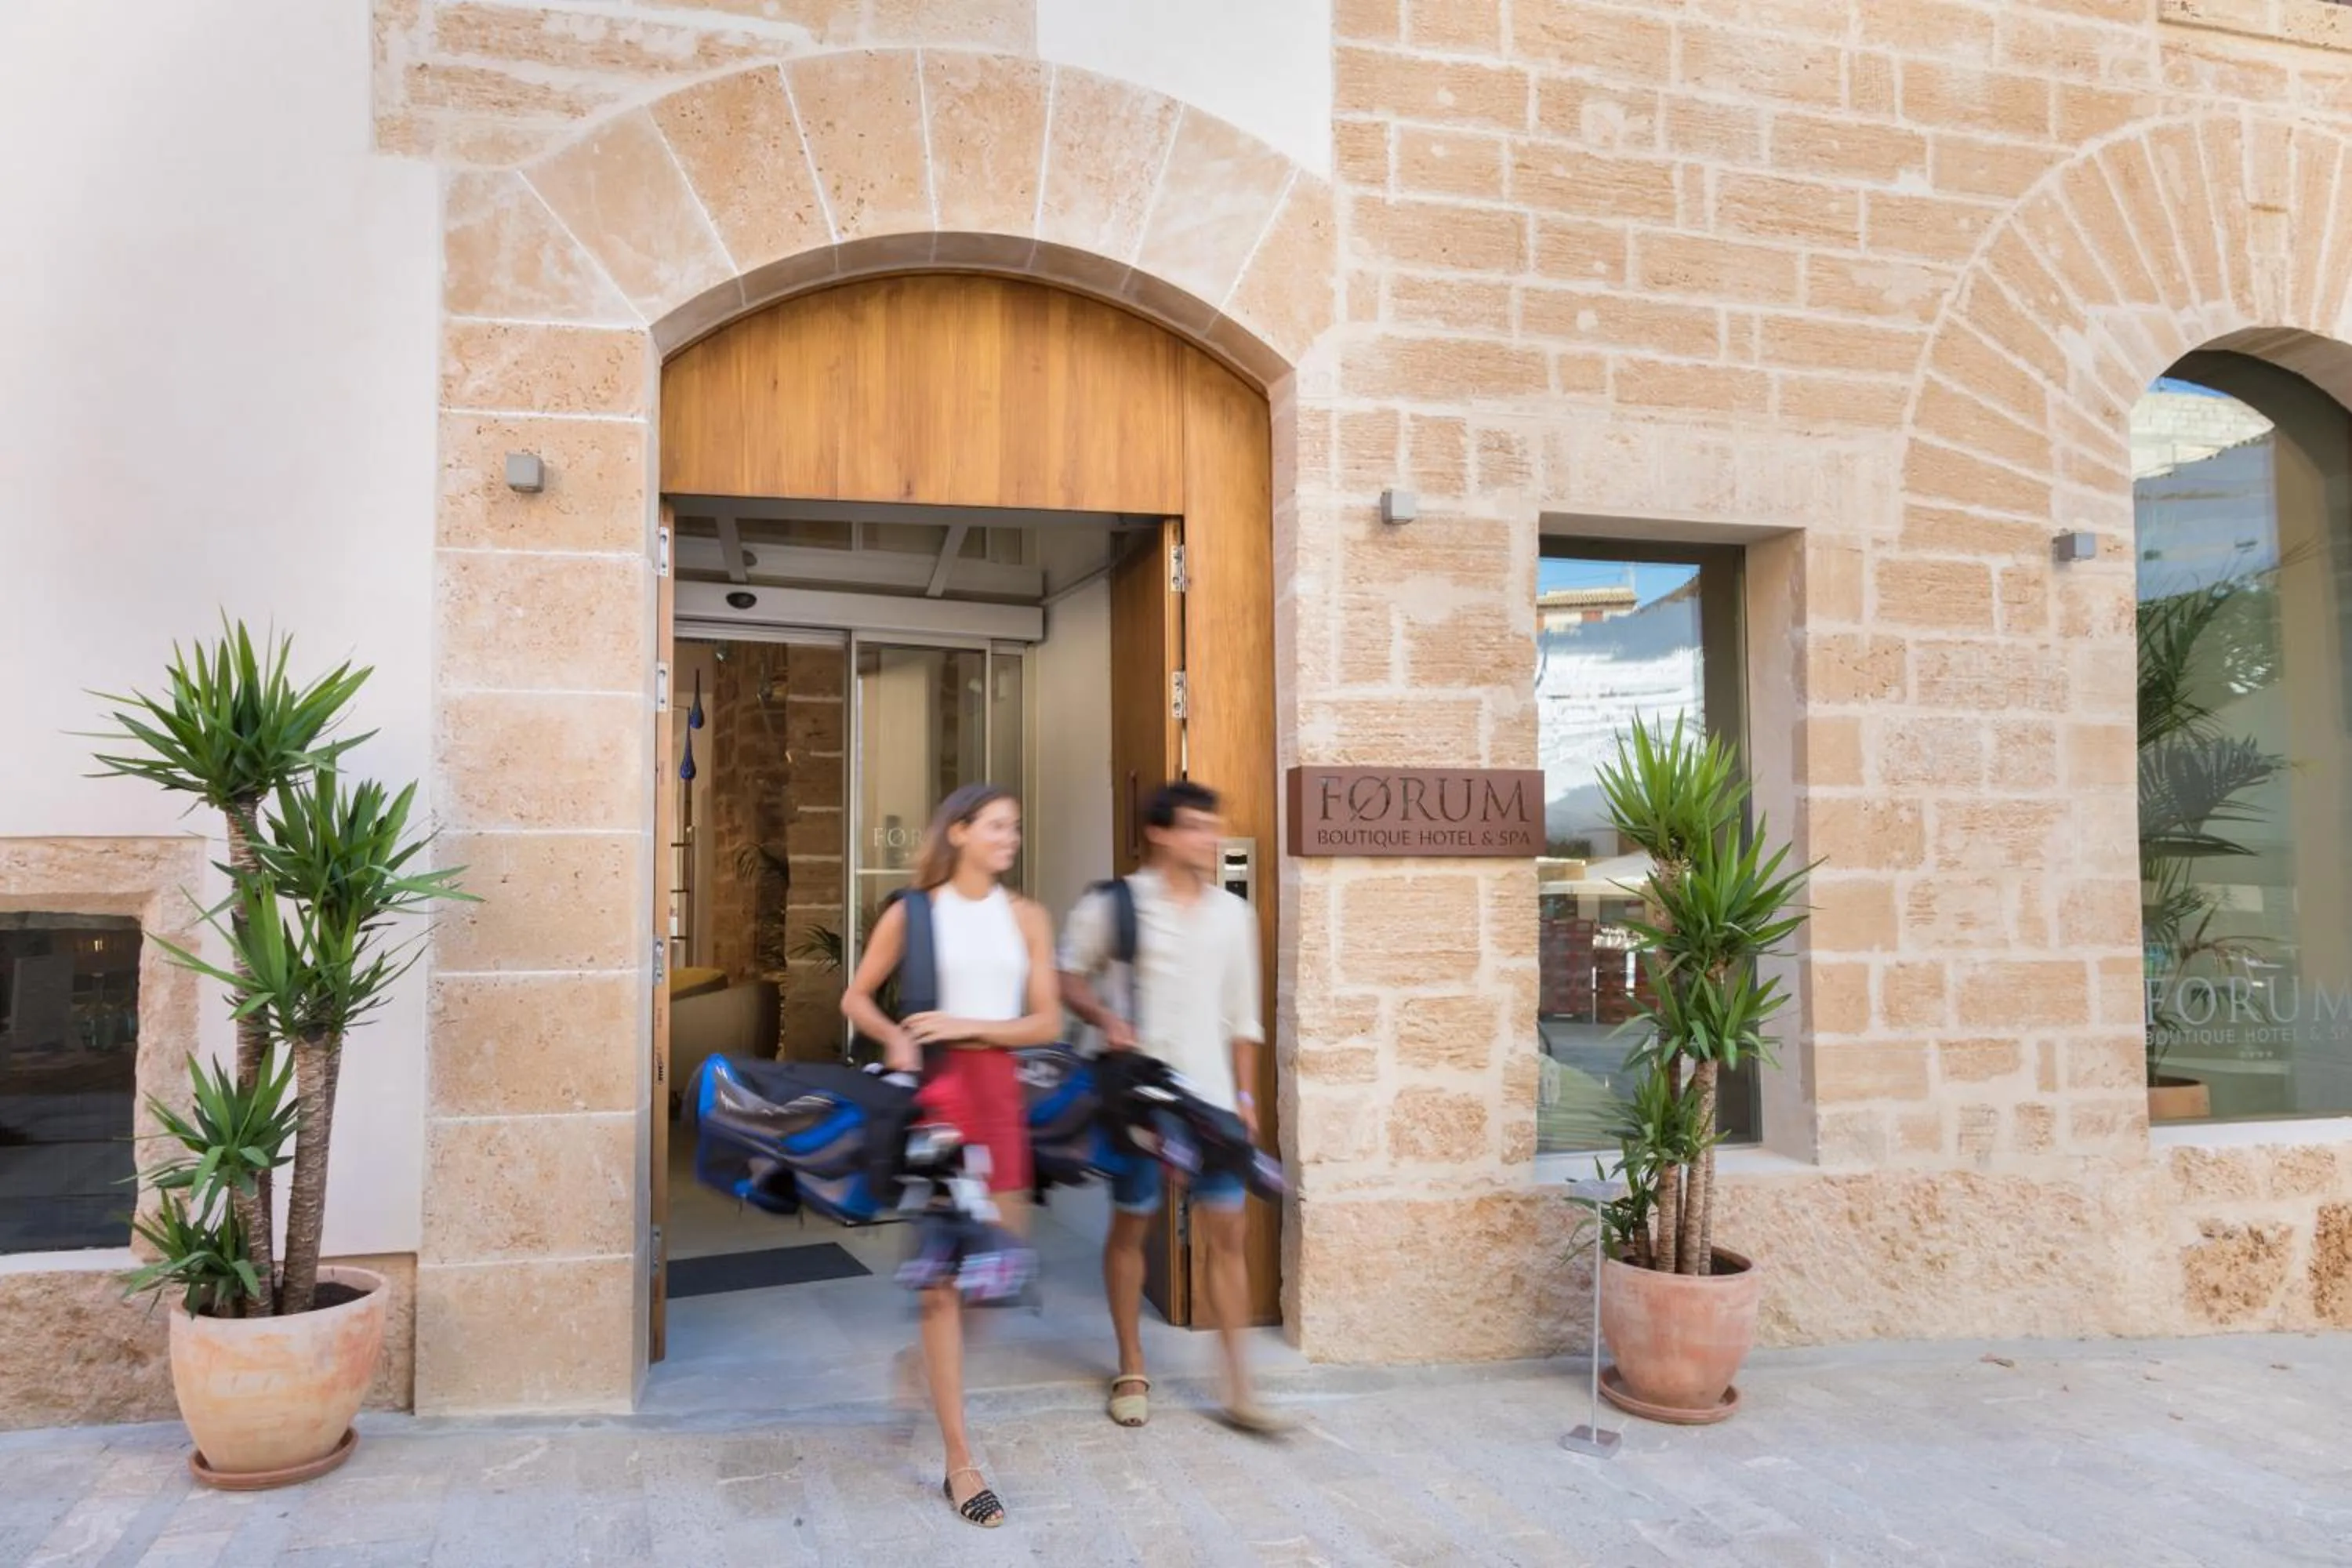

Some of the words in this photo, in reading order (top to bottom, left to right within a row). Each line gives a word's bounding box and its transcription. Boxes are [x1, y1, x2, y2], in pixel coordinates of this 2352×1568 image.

[1317, 829, 1412, 848] BOUTIQUE
[1419, 829, 1476, 846] HOTEL
[1481, 829, 1494, 846] &
[1498, 829, 1531, 846] SPA
[2145, 1028, 2234, 1047] BOUTIQUE
[2245, 1027, 2301, 1043] HOTEL
[2329, 1024, 2352, 1041] SP
